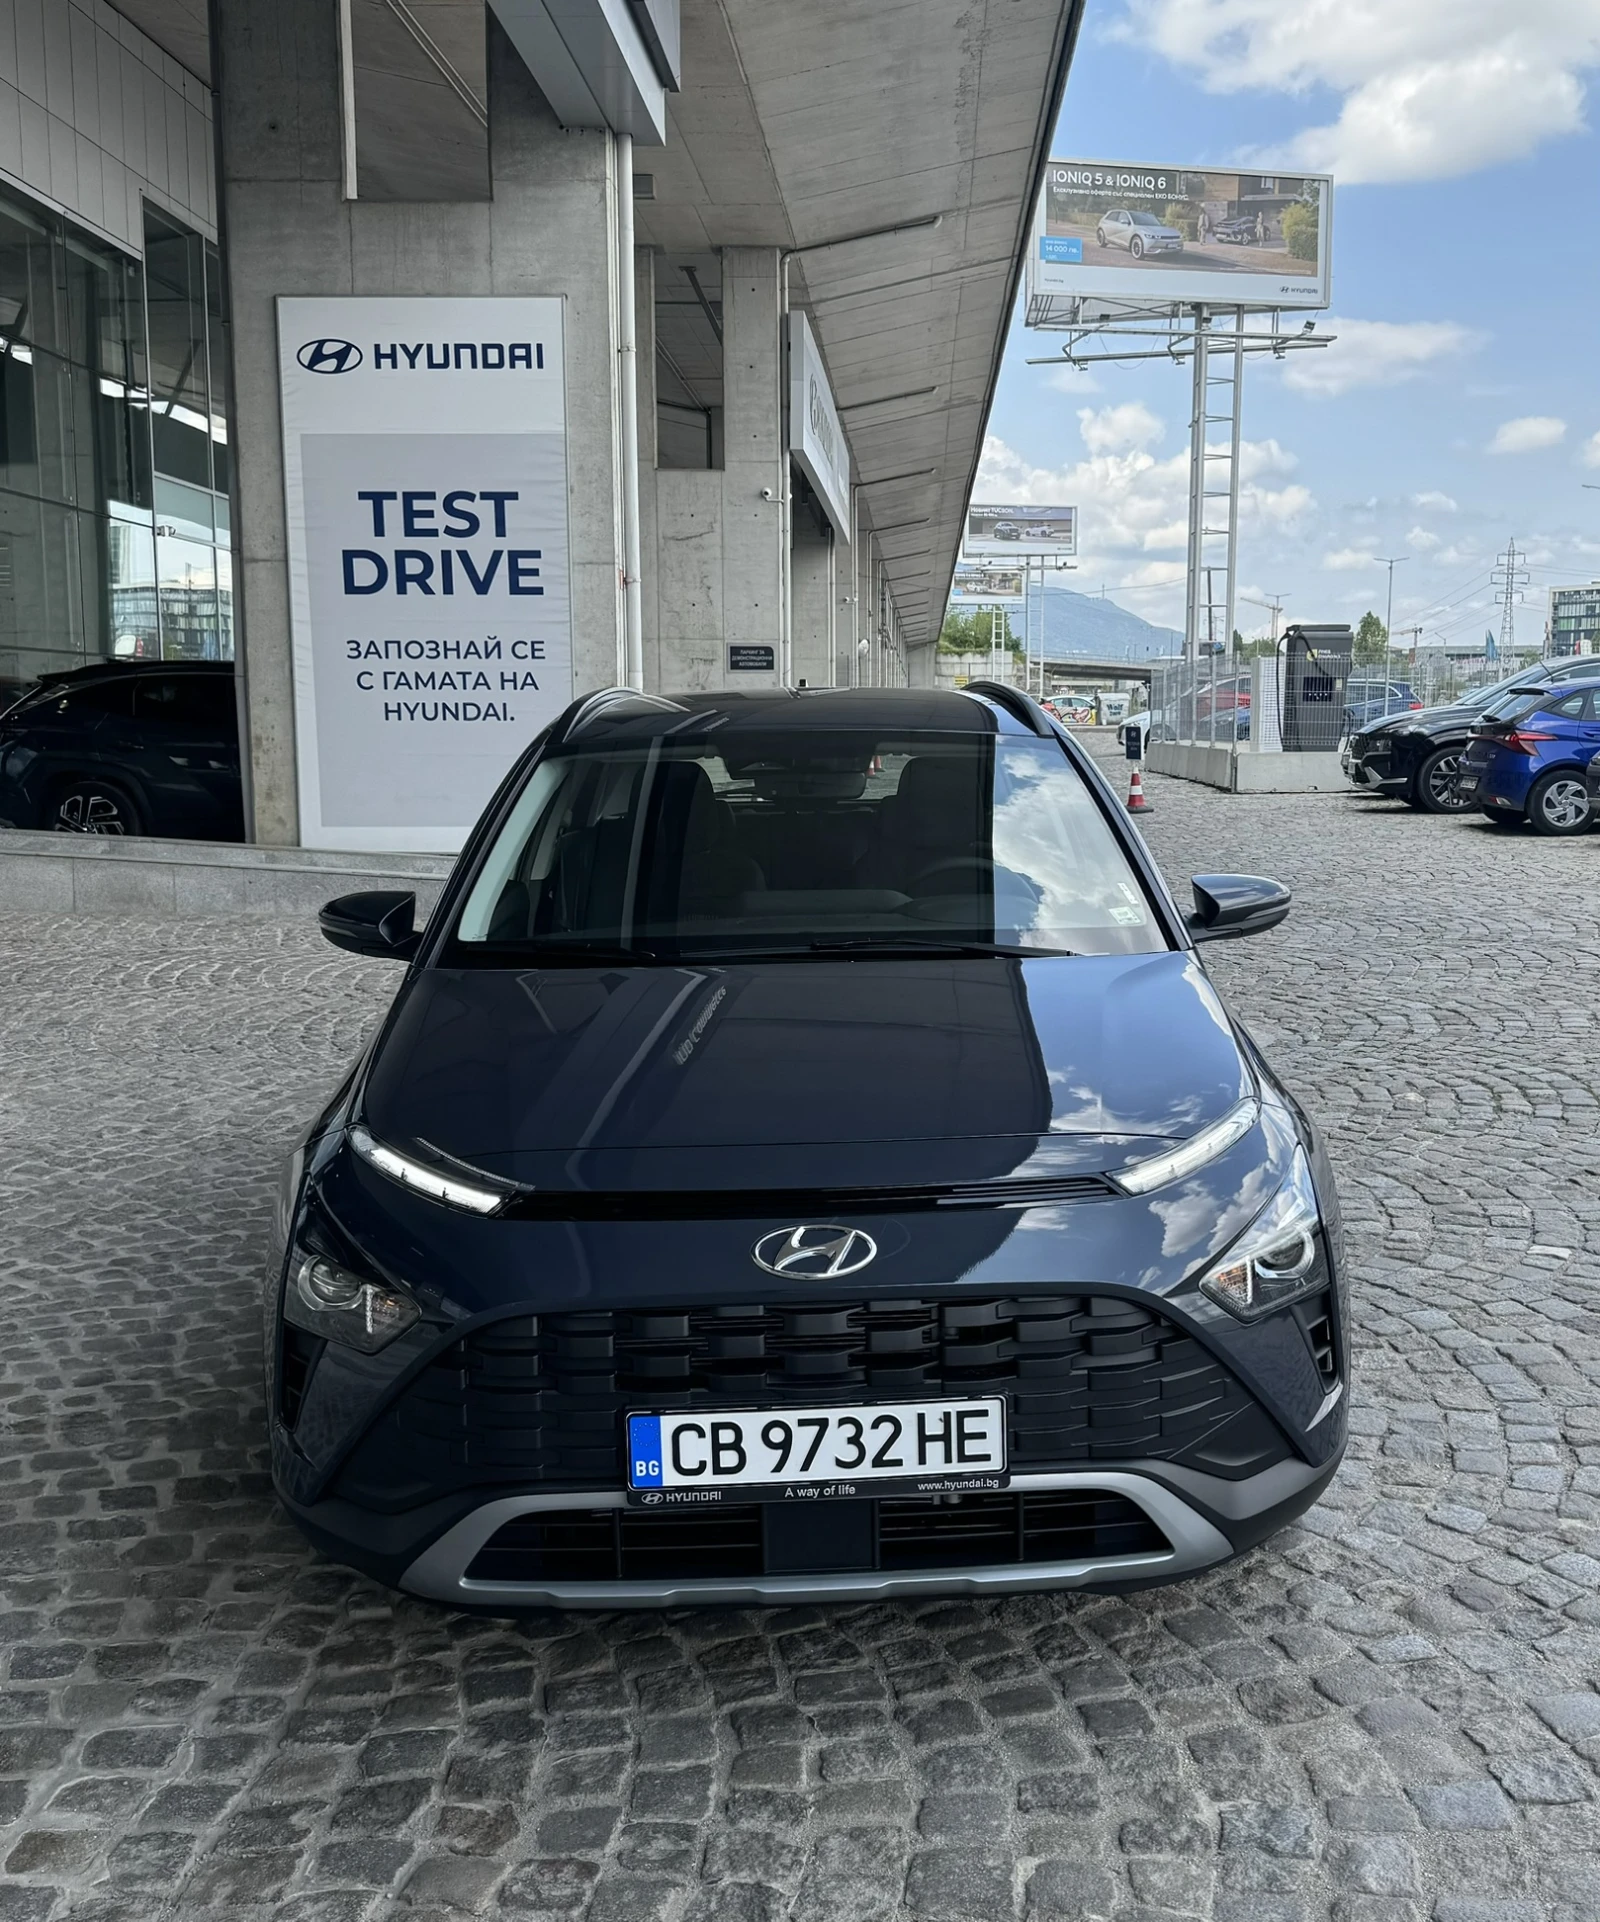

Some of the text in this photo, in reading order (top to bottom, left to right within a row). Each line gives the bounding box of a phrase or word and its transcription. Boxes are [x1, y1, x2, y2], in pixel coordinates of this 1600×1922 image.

[1053, 170, 1166, 191] IONIQ 5 & IONIQ 6
[1053, 187, 1090, 195] Ексклузивна
[374, 343, 544, 370] HYUNDAI
[358, 490, 519, 538] TEST
[341, 549, 544, 596] DRIVE
[346, 635, 546, 660] ЗАПОЗНАЙ СЕ
[356, 671, 539, 691] С ГАМАТА НА
[383, 702, 515, 722] HYUNDAI.
[671, 1408, 992, 1476] CB 9732 HE
[635, 1460, 660, 1477] BG
[785, 1484, 856, 1498] A way of life
[917, 1478, 999, 1491] www.hyundai.bg
[666, 1490, 722, 1502] HYUNDAI
